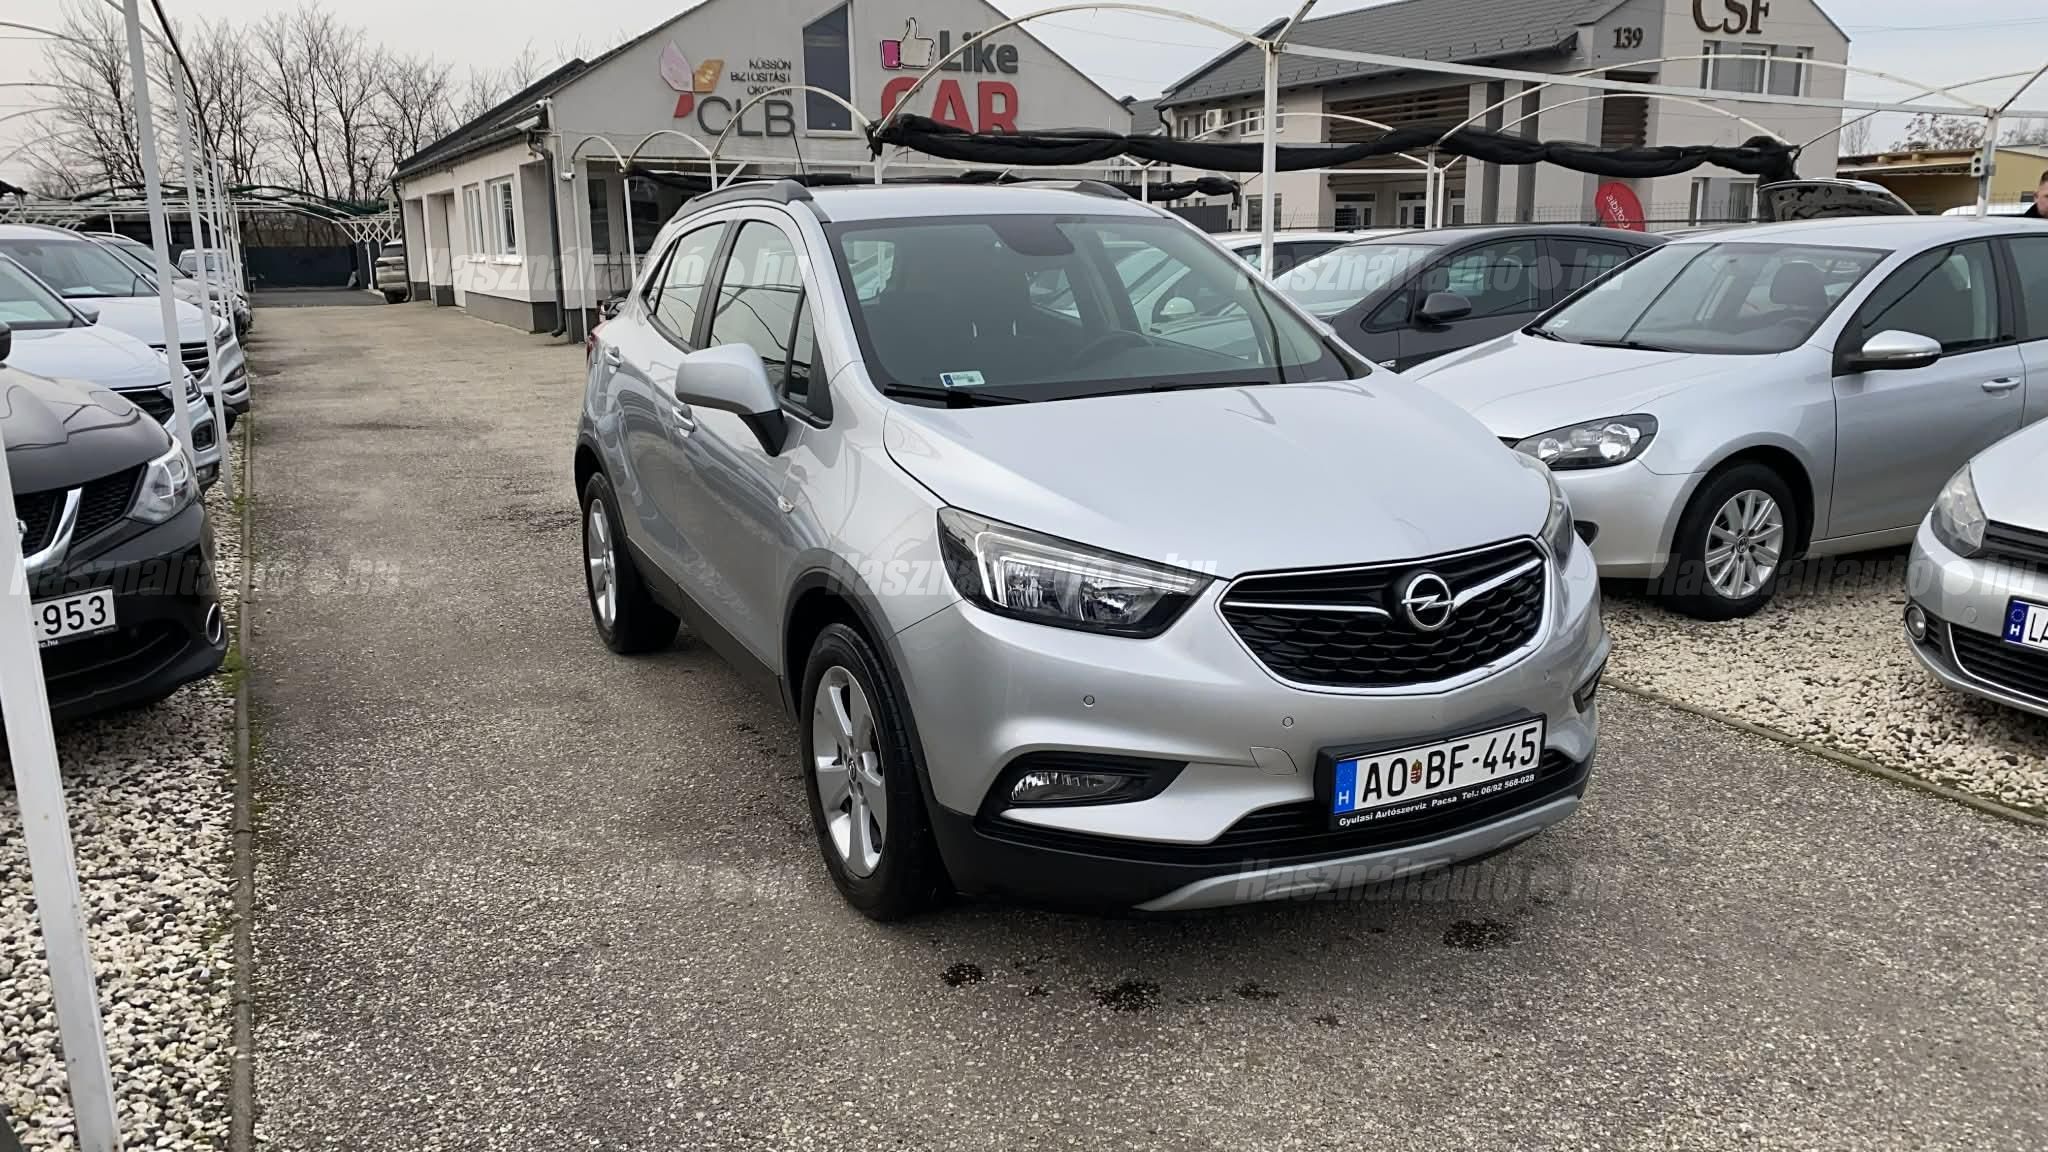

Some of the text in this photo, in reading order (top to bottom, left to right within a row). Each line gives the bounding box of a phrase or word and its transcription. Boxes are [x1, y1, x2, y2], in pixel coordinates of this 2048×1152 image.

[1692, 0, 1770, 34] CSF
[939, 30, 1018, 73] Like
[1613, 27, 1643, 48] 139
[697, 96, 795, 136] CLB
[881, 77, 1018, 135] CAR
[2010, 624, 2020, 636] H
[1425, 727, 1537, 790] BF-445
[1338, 790, 1350, 806] H
[1339, 812, 1374, 827] Gyulasi
[1375, 802, 1427, 820] Autószerviz
[1431, 796, 1457, 807] Pacsa
[1462, 790, 1479, 800] Tel.:
[1481, 782, 1503, 795] 06/92
